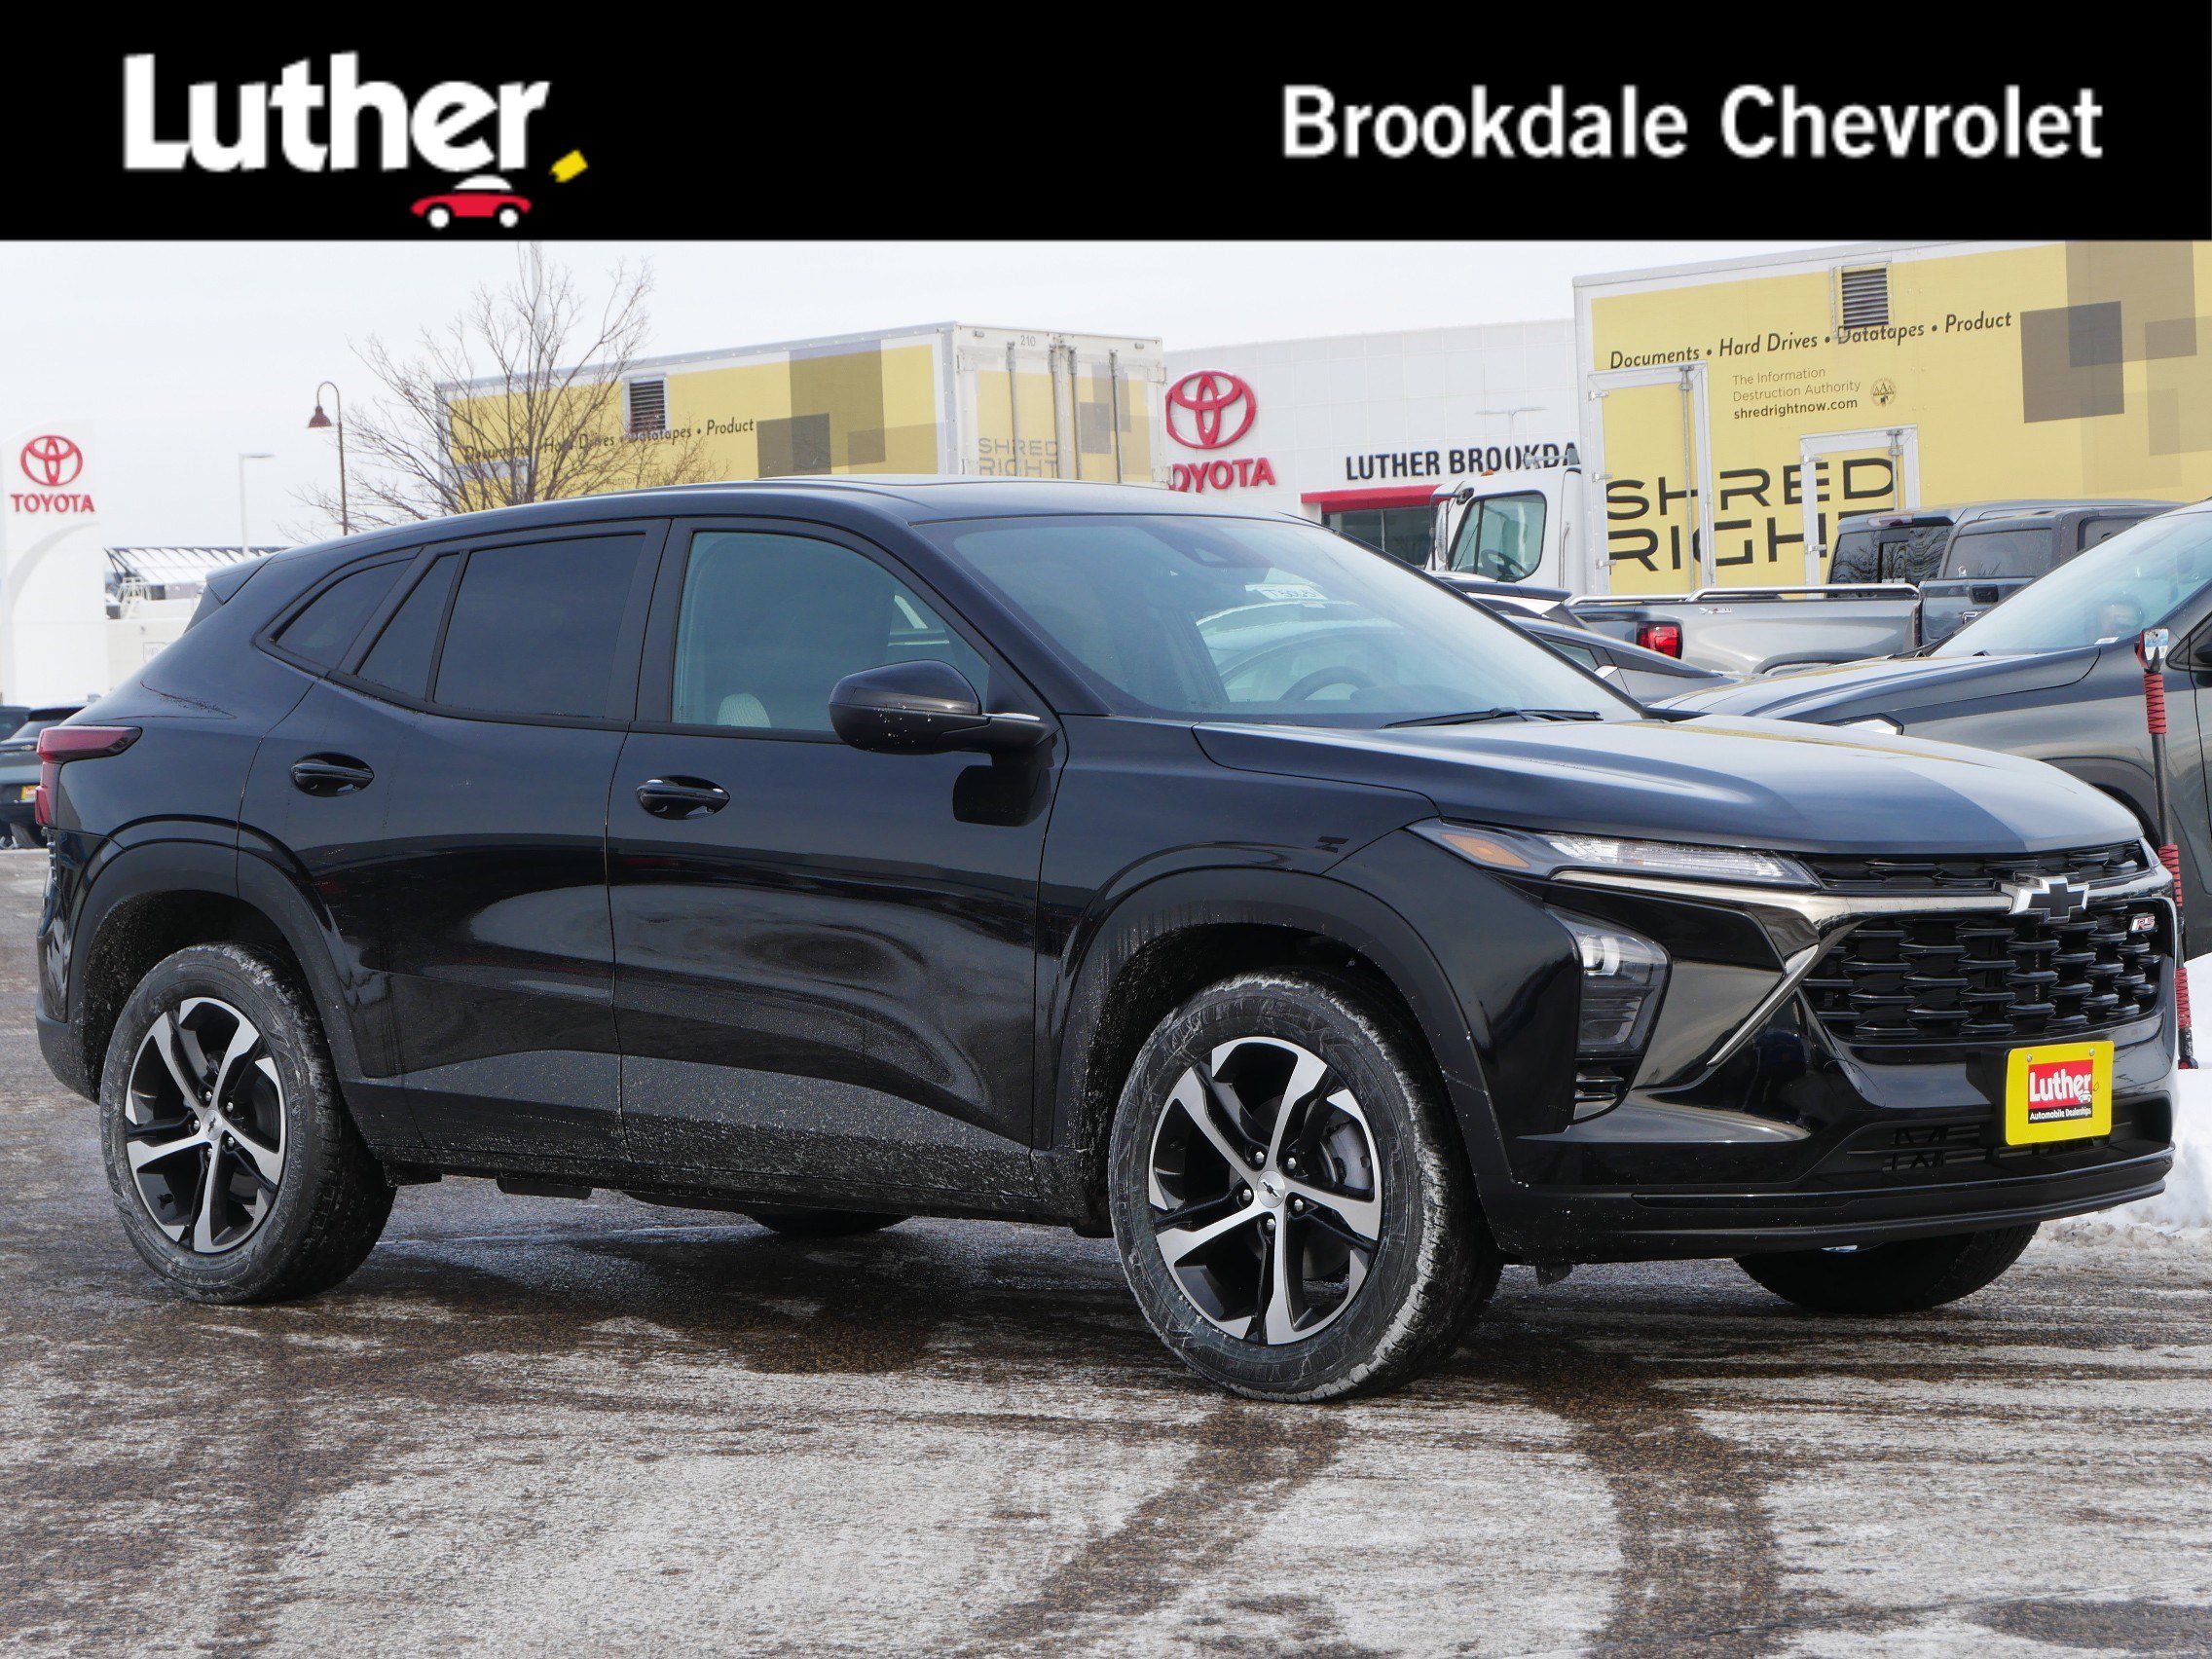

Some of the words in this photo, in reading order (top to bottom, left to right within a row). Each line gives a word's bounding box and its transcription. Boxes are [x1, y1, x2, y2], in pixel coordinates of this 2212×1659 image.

[1020, 334, 1036, 347] 210
[1610, 347, 1700, 369] Documents
[1719, 335, 1760, 356] Hard
[1767, 332, 1818, 351] Drives
[1837, 324, 1925, 346] Datatapes
[1945, 311, 2012, 333] Product
[1732, 375, 1753, 386] The
[1757, 367, 1826, 383] Information
[1733, 387, 1801, 402] Destruction
[1804, 380, 1861, 395] Authority
[1734, 398, 1859, 420] shredrightnow.com
[707, 417, 755, 435] Product
[978, 437, 1057, 457] SHRED
[1346, 450, 1440, 481] LUTHER
[1606, 458, 1896, 521] SHRED
[10, 493, 95, 513] TOYOTA
[2137, 916, 2156, 930] RS
[2029, 1068, 2092, 1103] Luther
[2030, 1109, 2065, 1121] Automobile
[2065, 1106, 2092, 1118] Dealerships
